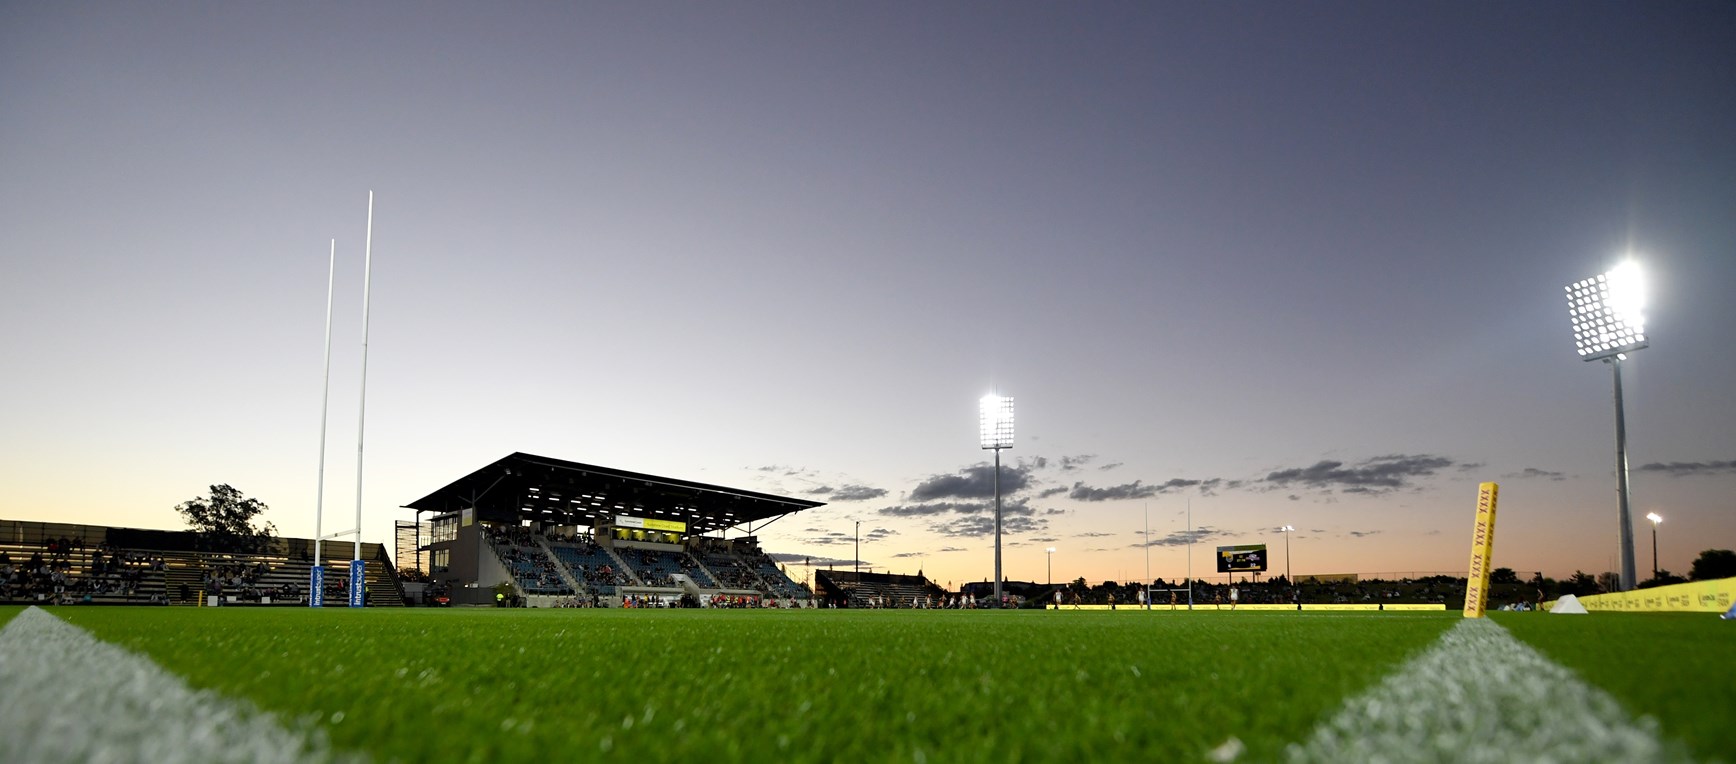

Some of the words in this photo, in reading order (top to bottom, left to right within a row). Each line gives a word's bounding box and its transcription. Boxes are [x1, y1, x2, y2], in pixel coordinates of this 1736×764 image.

[1479, 489, 1489, 513] XXXX
[1475, 521, 1486, 545] XXXX
[1471, 554, 1482, 578] XXXX
[1467, 586, 1478, 611] XXXX
